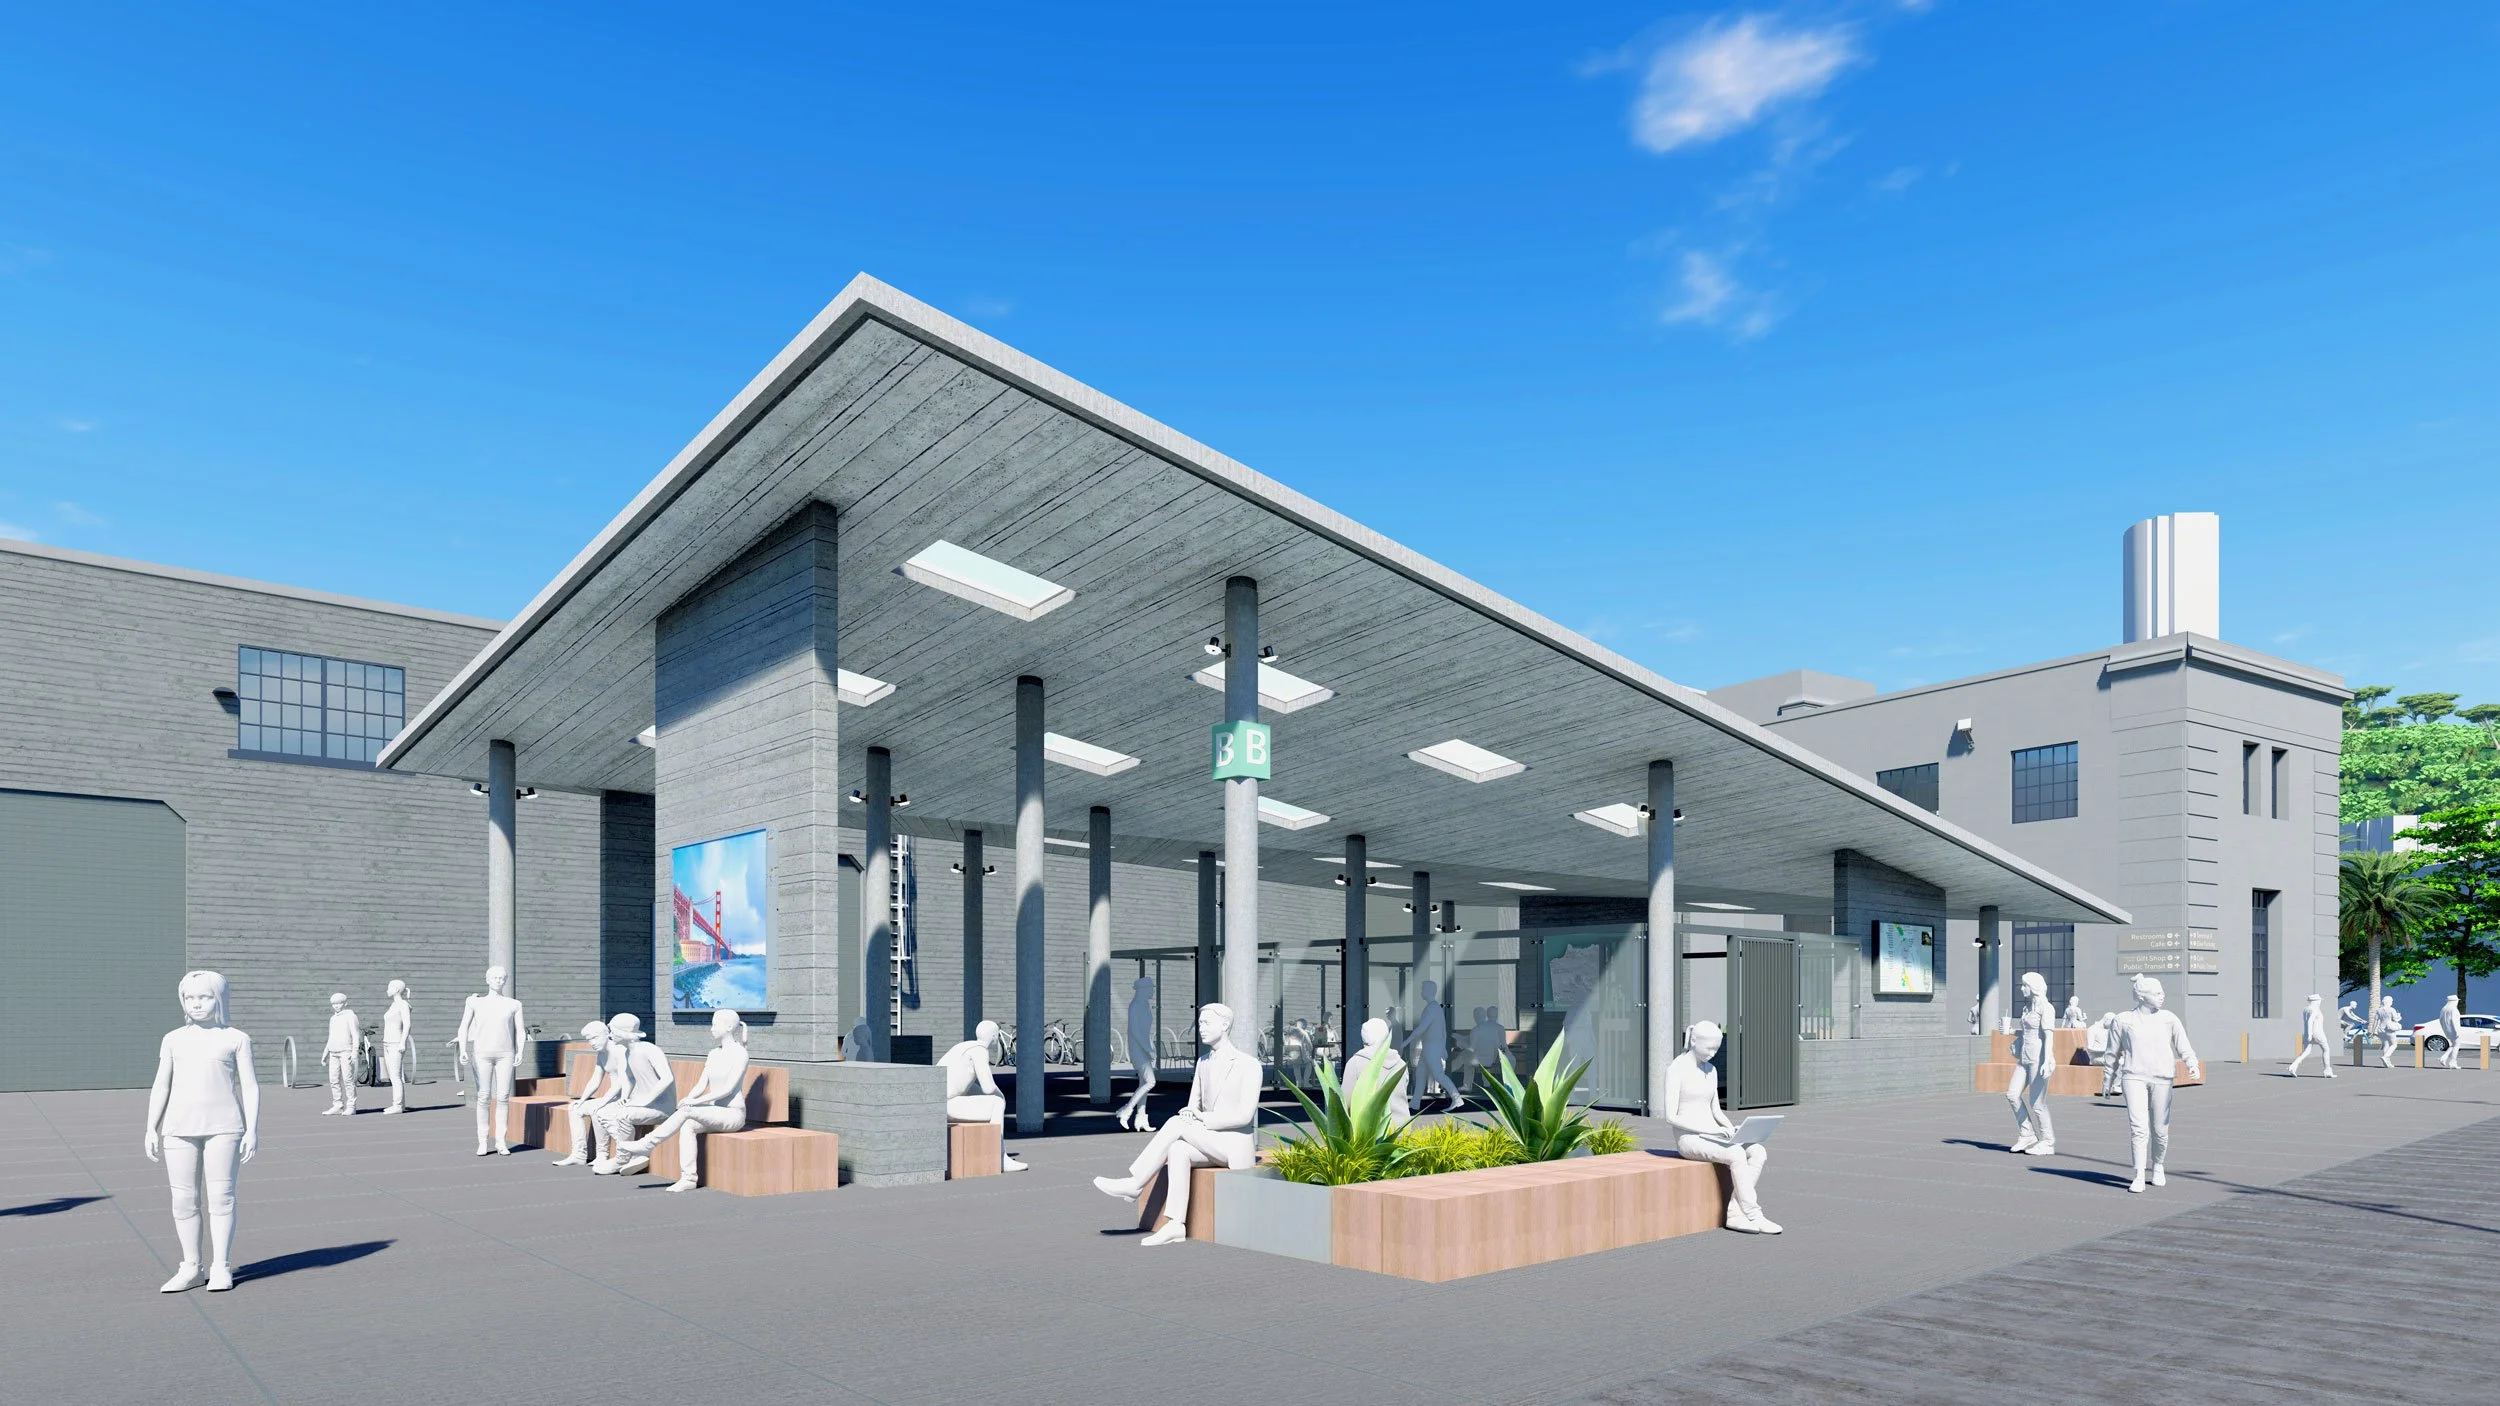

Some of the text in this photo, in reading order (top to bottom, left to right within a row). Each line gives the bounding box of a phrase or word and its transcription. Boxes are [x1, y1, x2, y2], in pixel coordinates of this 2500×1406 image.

[1215, 732, 1234, 767] B
[1246, 729, 1266, 765] B
[2149, 954, 2166, 963] Shop
